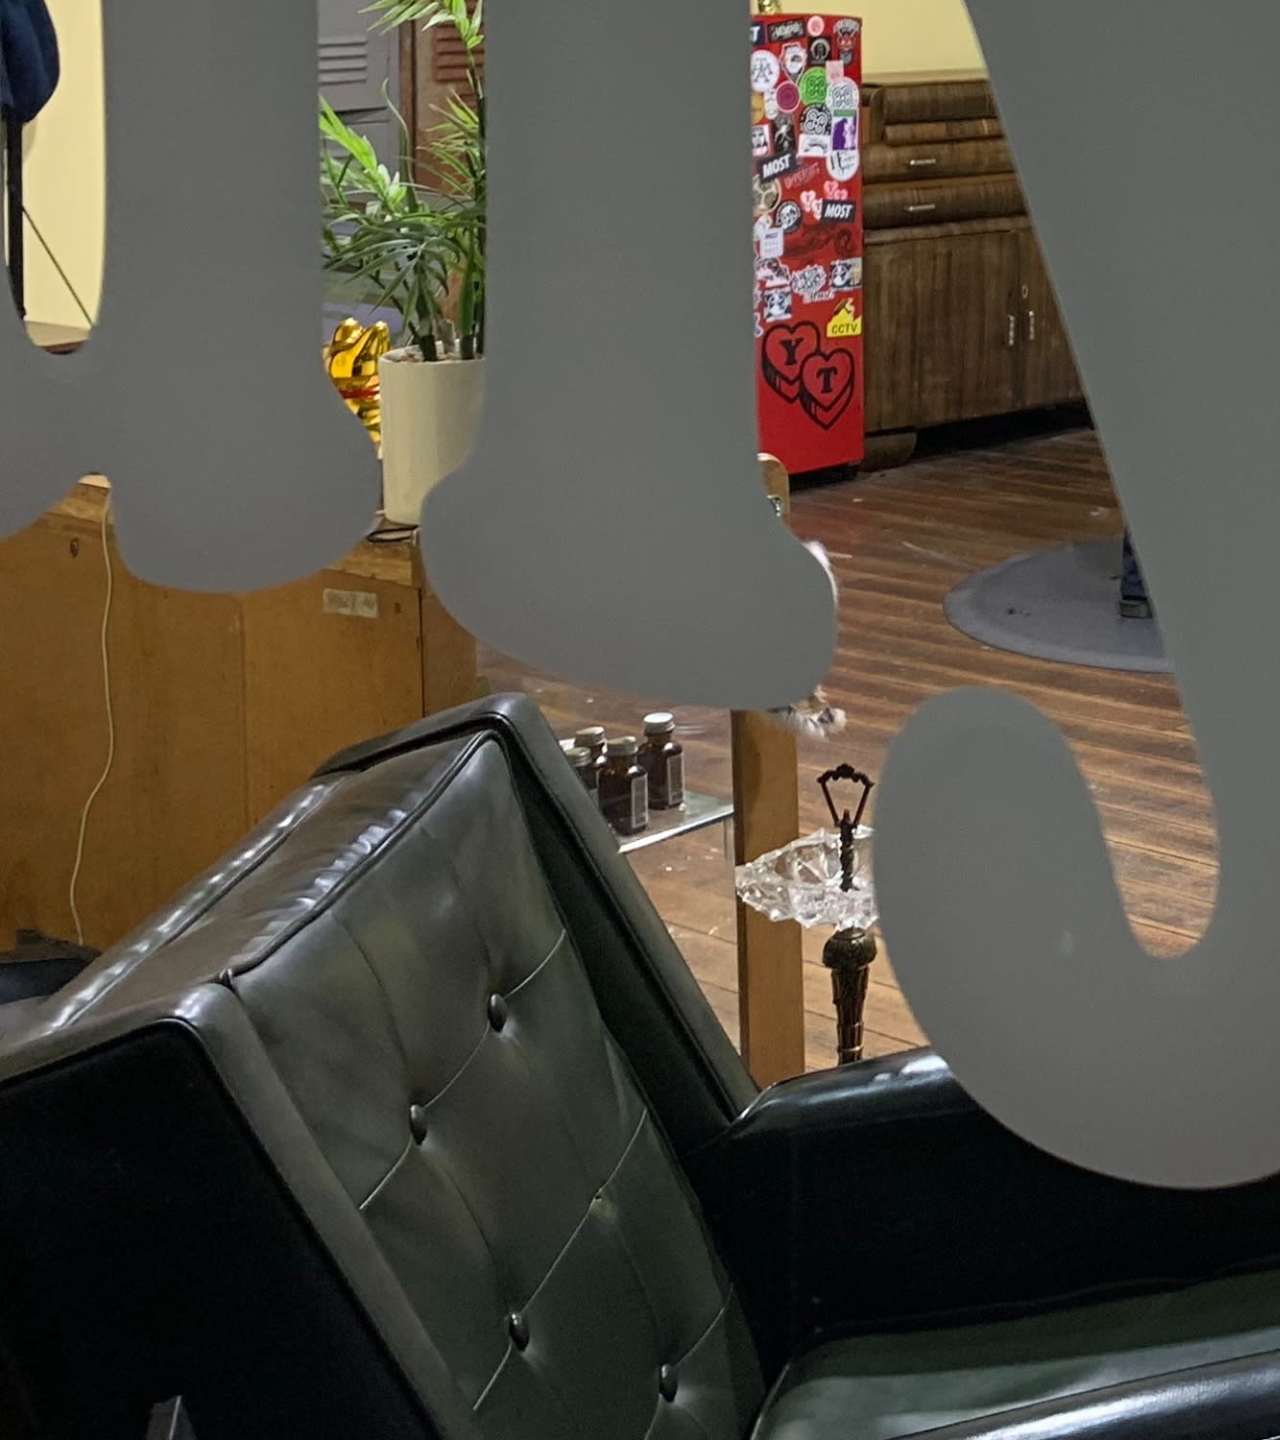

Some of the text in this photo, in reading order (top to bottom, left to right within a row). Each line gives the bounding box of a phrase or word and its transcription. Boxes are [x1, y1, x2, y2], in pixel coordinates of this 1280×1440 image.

[762, 153, 792, 179] MOST
[824, 203, 854, 219] MOST
[831, 323, 859, 334] CCTV
[779, 337, 805, 366] Y
[815, 366, 838, 394] T
